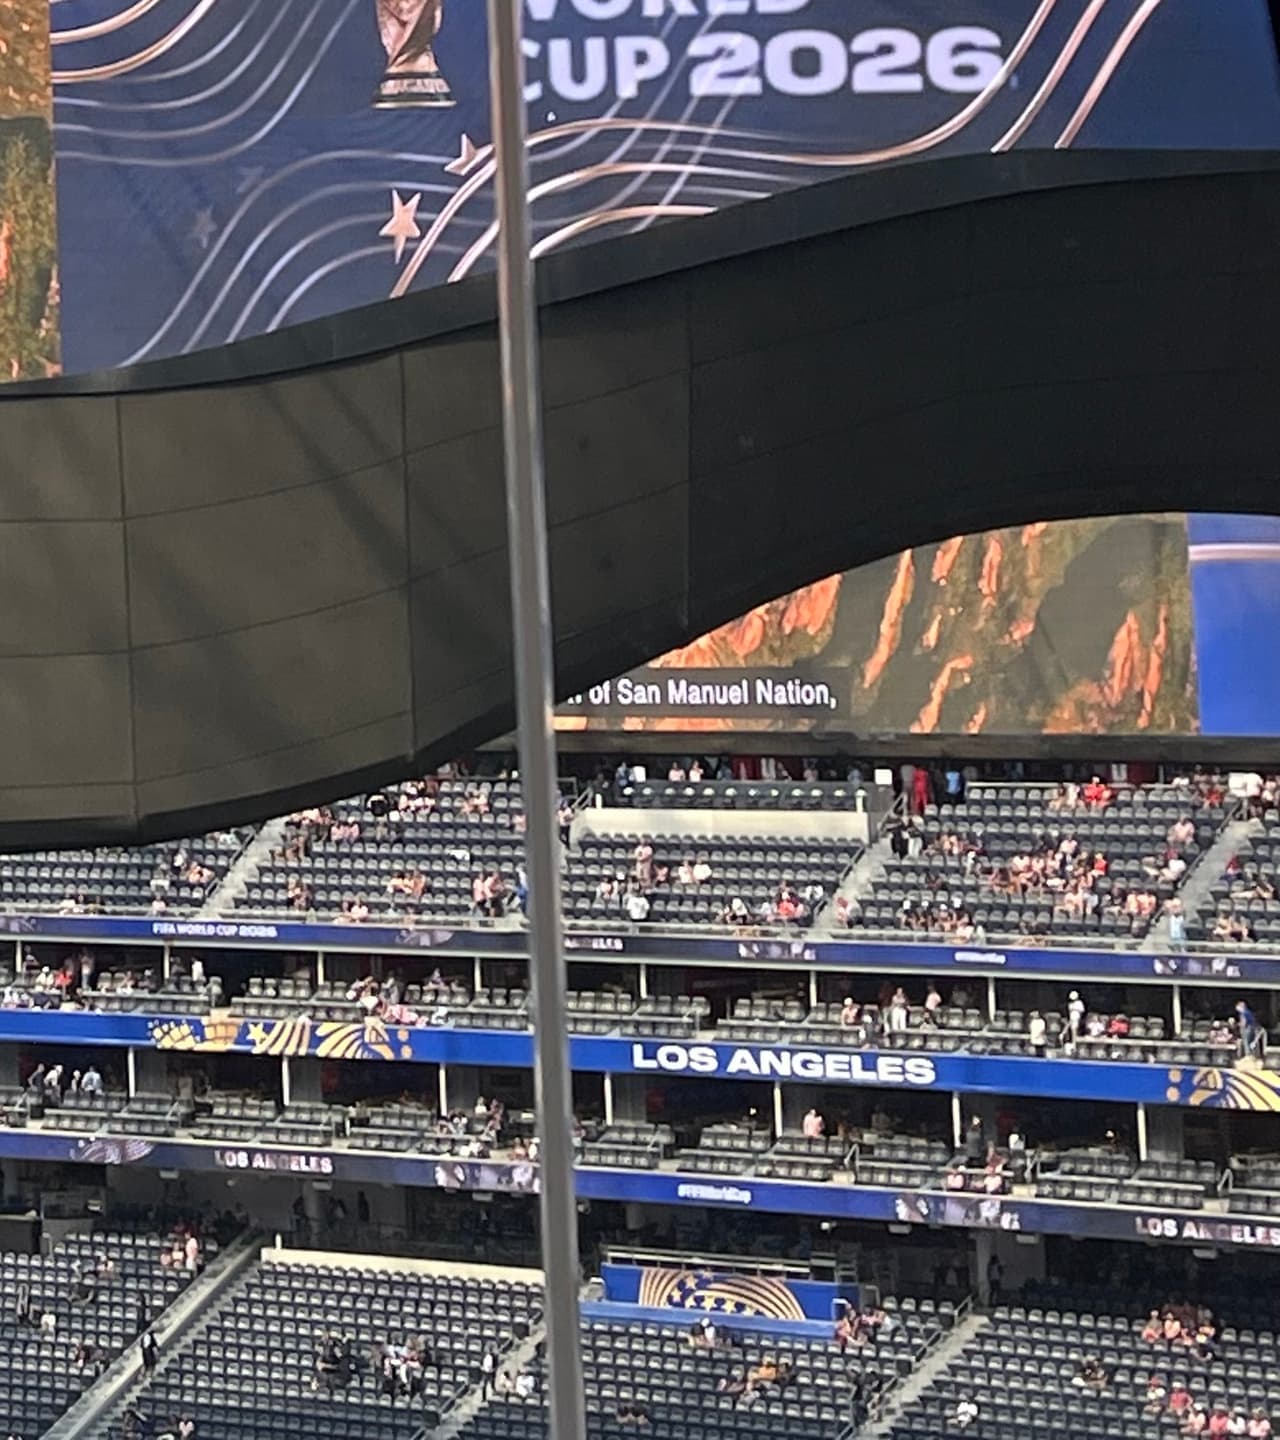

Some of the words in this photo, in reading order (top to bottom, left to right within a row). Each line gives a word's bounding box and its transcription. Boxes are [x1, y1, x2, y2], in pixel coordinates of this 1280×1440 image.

[687, 27, 1003, 97] 2026
[589, 678, 612, 704] of
[617, 679, 661, 705] San
[668, 679, 750, 705] Manuel
[756, 679, 836, 709] Nation,
[176, 923, 216, 936] WORLD
[216, 924, 238, 936] CUP
[632, 1044, 718, 1072] LOS
[725, 1050, 936, 1084] ANGELES
[215, 1150, 248, 1167] LOS
[1135, 1216, 1178, 1237] LOS
